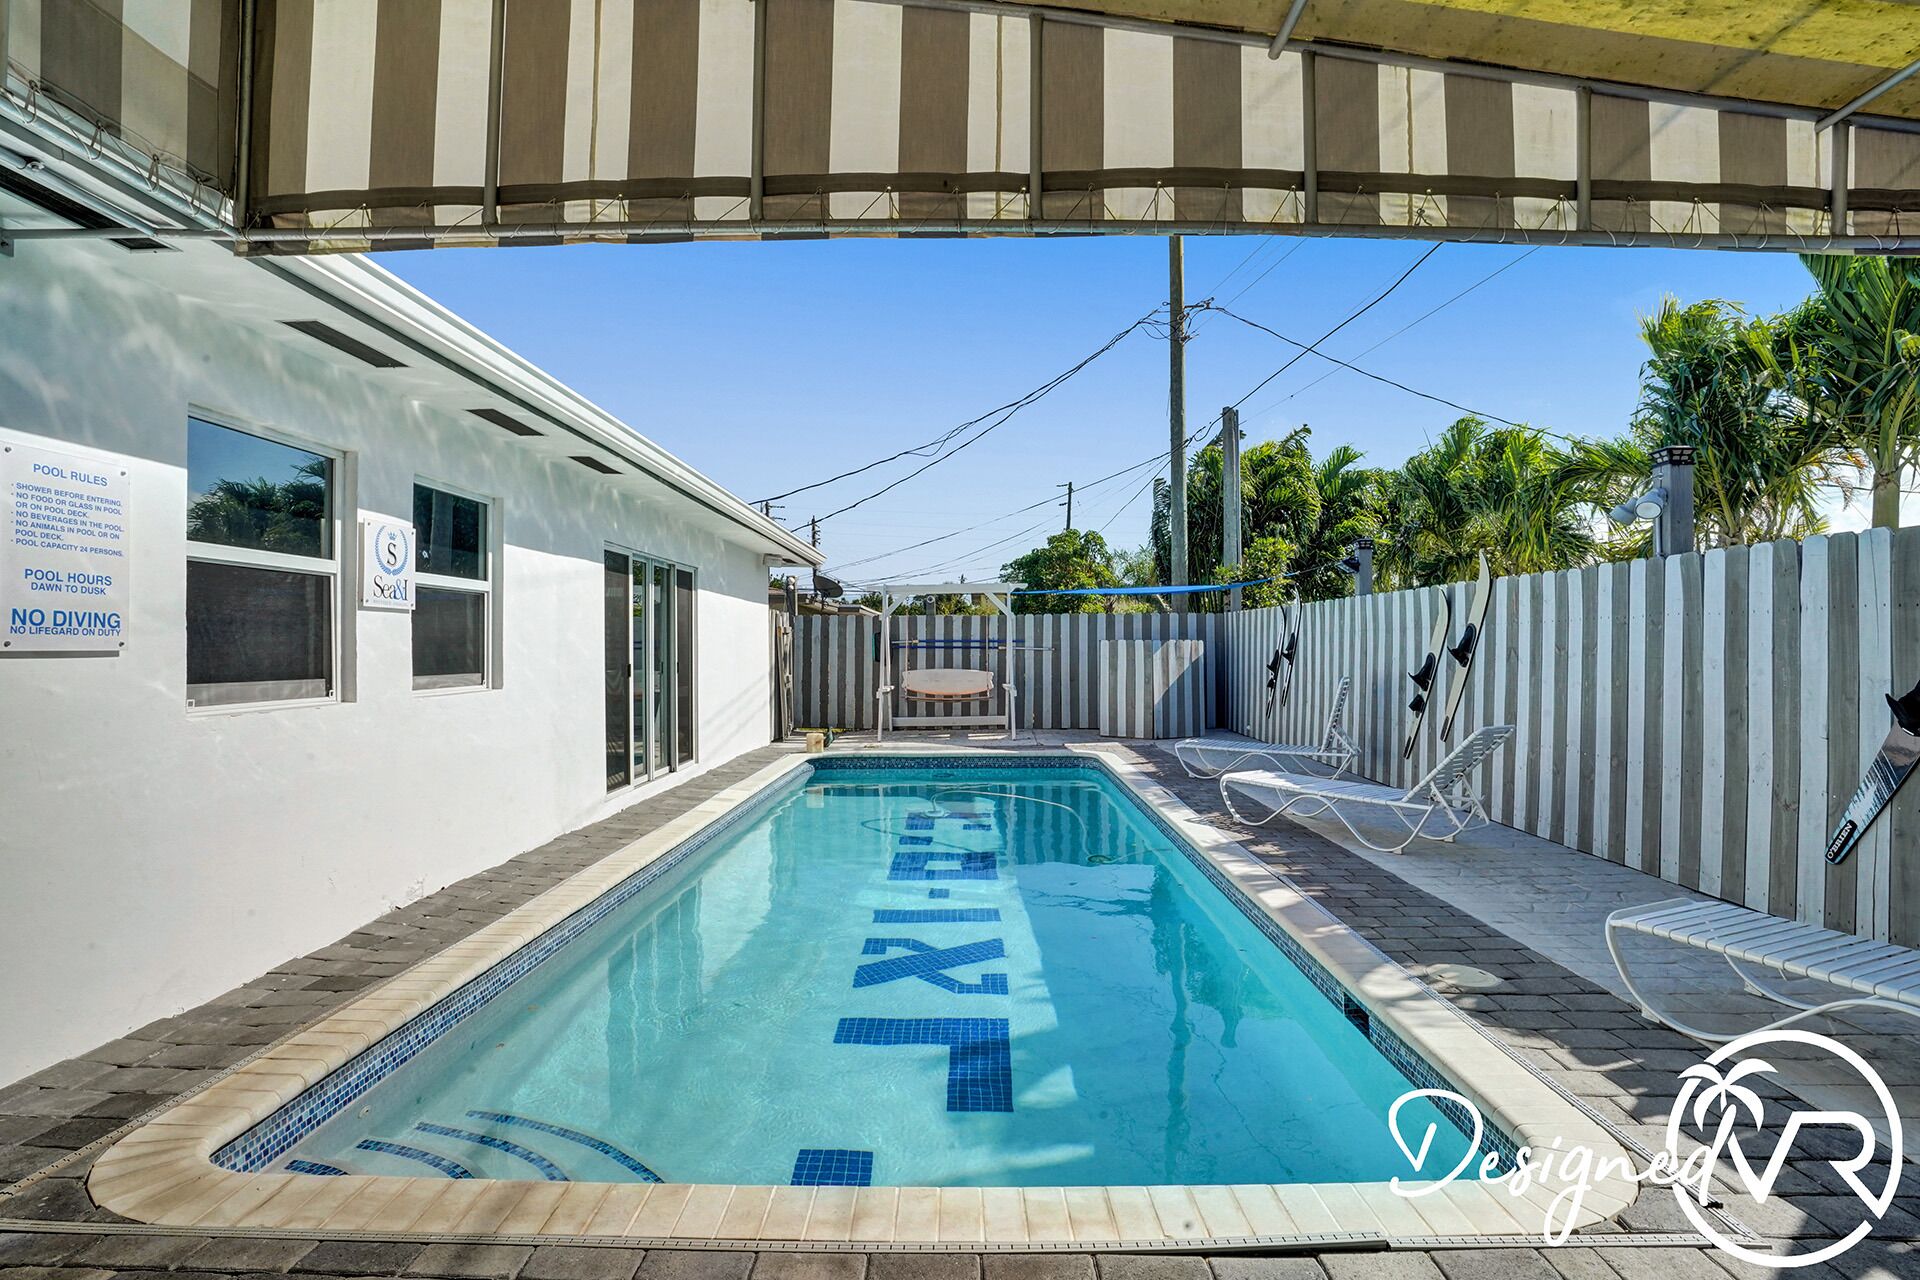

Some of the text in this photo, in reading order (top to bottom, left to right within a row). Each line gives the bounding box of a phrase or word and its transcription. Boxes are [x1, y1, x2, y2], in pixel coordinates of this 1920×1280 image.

[33, 463, 108, 487] POOL RULES
[16, 482, 52, 495] SHOWER
[54, 489, 84, 501] BEFORE
[16, 492, 122, 516] NO FOOD OR GLASS IN POOL
[30, 503, 42, 511] ON
[44, 505, 66, 515] POOL
[30, 512, 78, 525] BEVERAGES
[89, 521, 103, 529] THE
[16, 529, 38, 538] POOL
[30, 521, 65, 533] ANIMALS
[76, 528, 96, 537] POOL
[98, 531, 108, 539] OR
[109, 532, 120, 540] ON
[16, 538, 38, 547] POOL
[40, 541, 78, 552] CAPACITY
[387, 542, 397, 566] S
[24, 568, 112, 587] POOL HOURS
[31, 582, 106, 595] DAWN TO DUSK
[11, 608, 121, 629] NO DIVING
[10, 625, 121, 637] NO LIFEGARD ON DUTY
[1827, 822, 1853, 859] O'BRIEN
